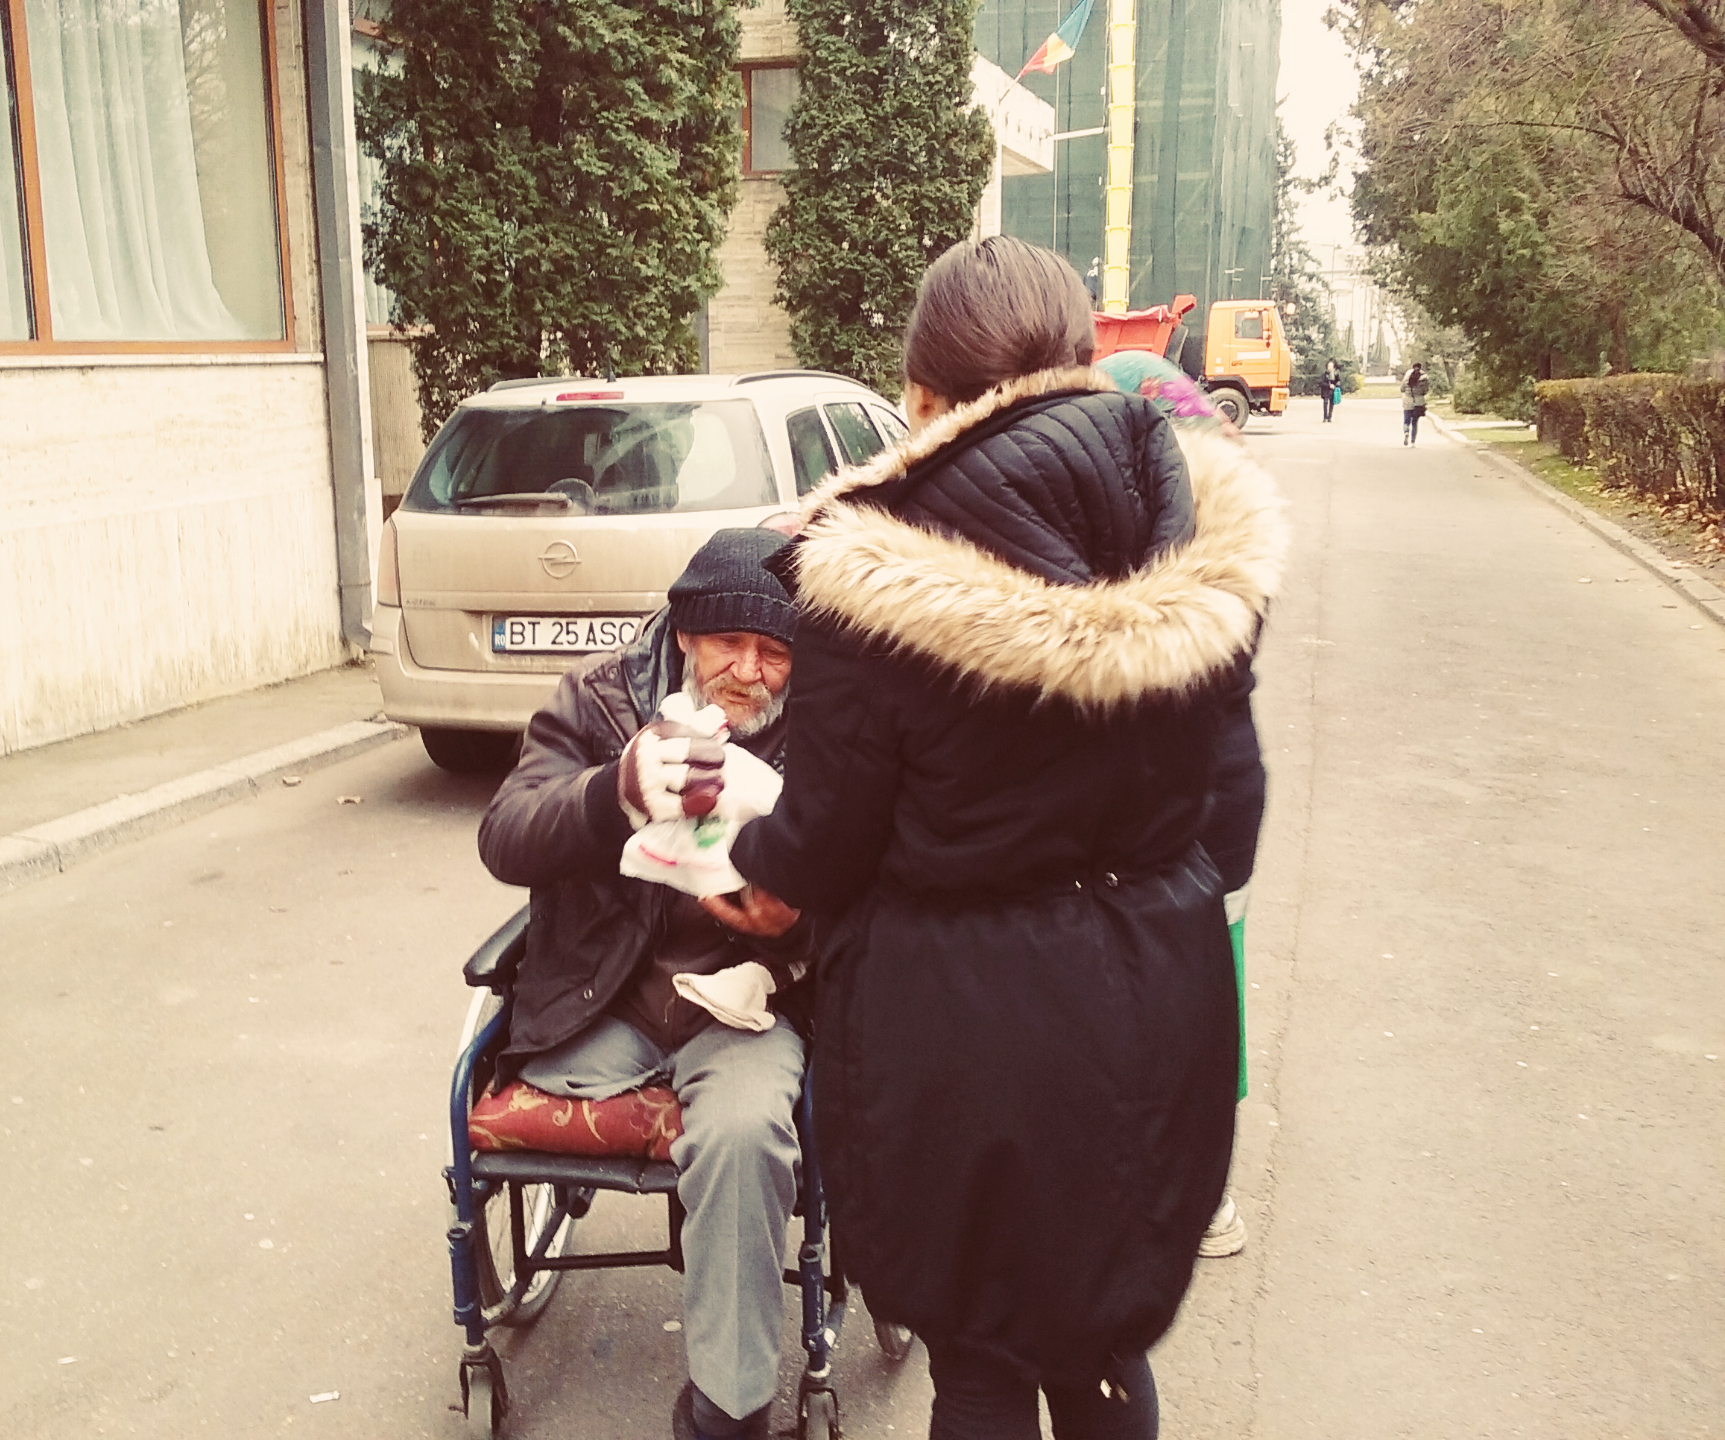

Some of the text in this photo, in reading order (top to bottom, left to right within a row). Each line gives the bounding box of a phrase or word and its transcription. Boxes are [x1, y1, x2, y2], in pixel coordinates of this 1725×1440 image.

[510, 621, 635, 646] BT 25 ASC
